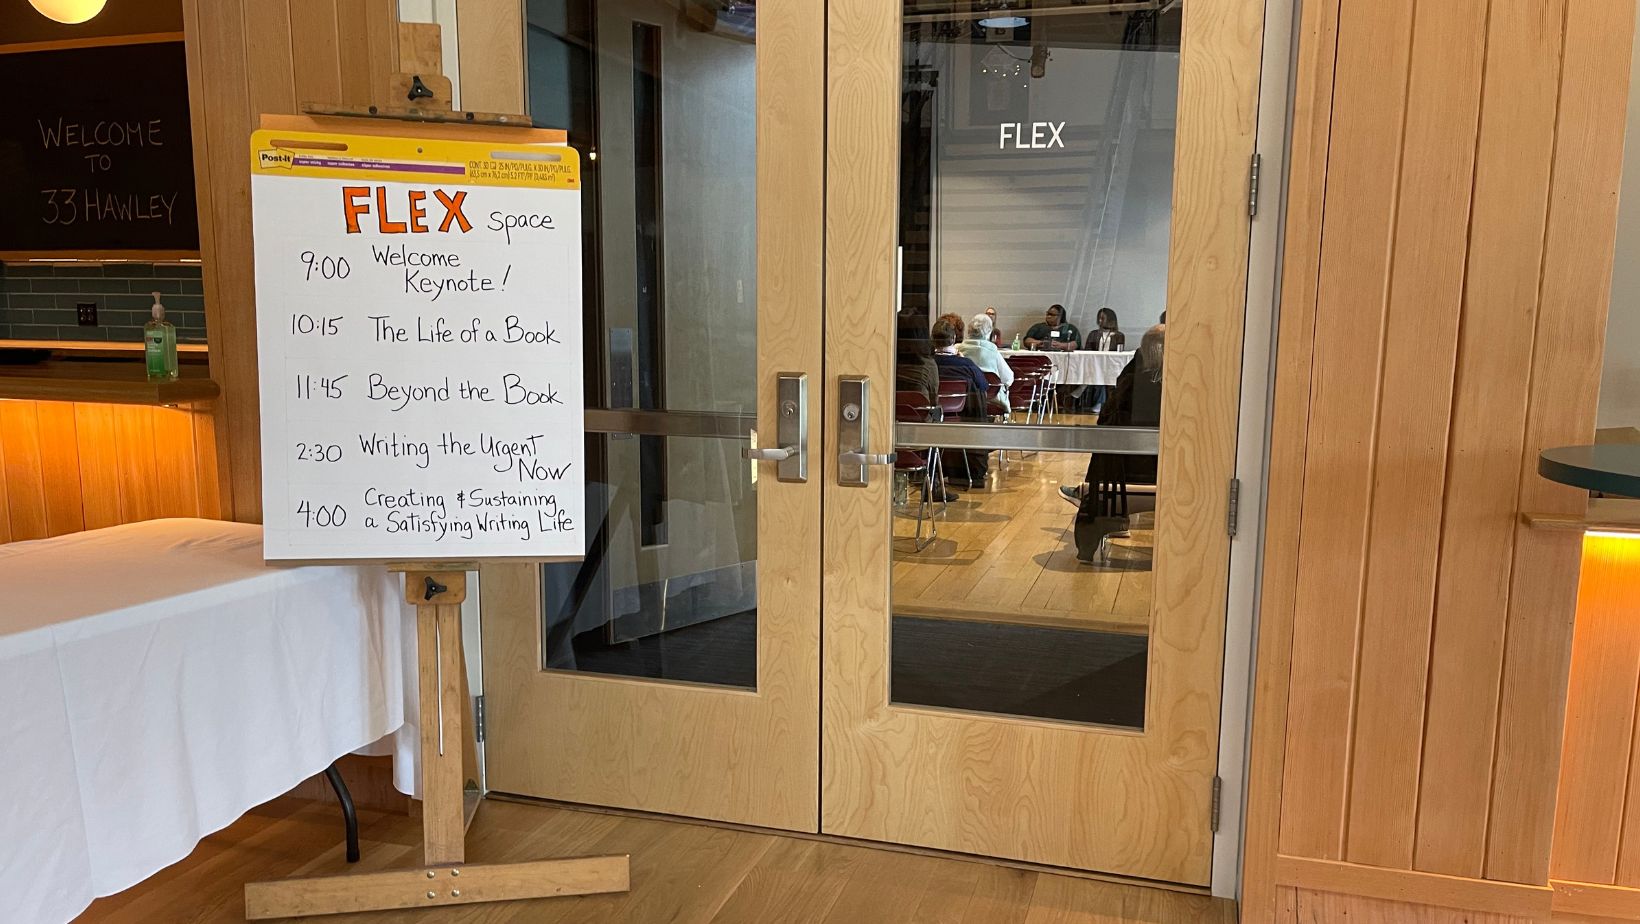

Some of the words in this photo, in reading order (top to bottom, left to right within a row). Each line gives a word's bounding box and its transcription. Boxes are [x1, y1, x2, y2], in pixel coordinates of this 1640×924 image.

[38, 116, 164, 149] WELCOME
[1000, 121, 1066, 149] FLEX
[84, 154, 111, 173] TO
[262, 153, 291, 163] Post-it
[41, 189, 77, 225] 33
[85, 188, 178, 225] HAWLEY
[342, 185, 473, 234] FLEX
[487, 210, 555, 245] space
[300, 251, 351, 281] 9:00
[372, 244, 461, 267] Welcome
[292, 314, 343, 336] 10:15
[368, 315, 408, 342] The
[418, 316, 454, 343] Life
[460, 317, 481, 343] of
[485, 329, 498, 342] a
[503, 315, 561, 344] Book
[297, 374, 349, 399] 11:45
[367, 373, 450, 412] Beyond
[458, 380, 495, 402] the
[503, 373, 563, 405] Book
[297, 442, 343, 462] 2:30
[359, 432, 430, 468] Writing
[437, 432, 476, 456] the
[518, 458, 572, 482] Now
[297, 500, 347, 527] 4:00
[364, 487, 446, 519] Creating
[469, 487, 557, 518] Sustaining
[365, 516, 379, 528] a
[387, 510, 473, 542] Satisfying
[475, 511, 530, 541] Writing
[538, 509, 575, 533] Life
